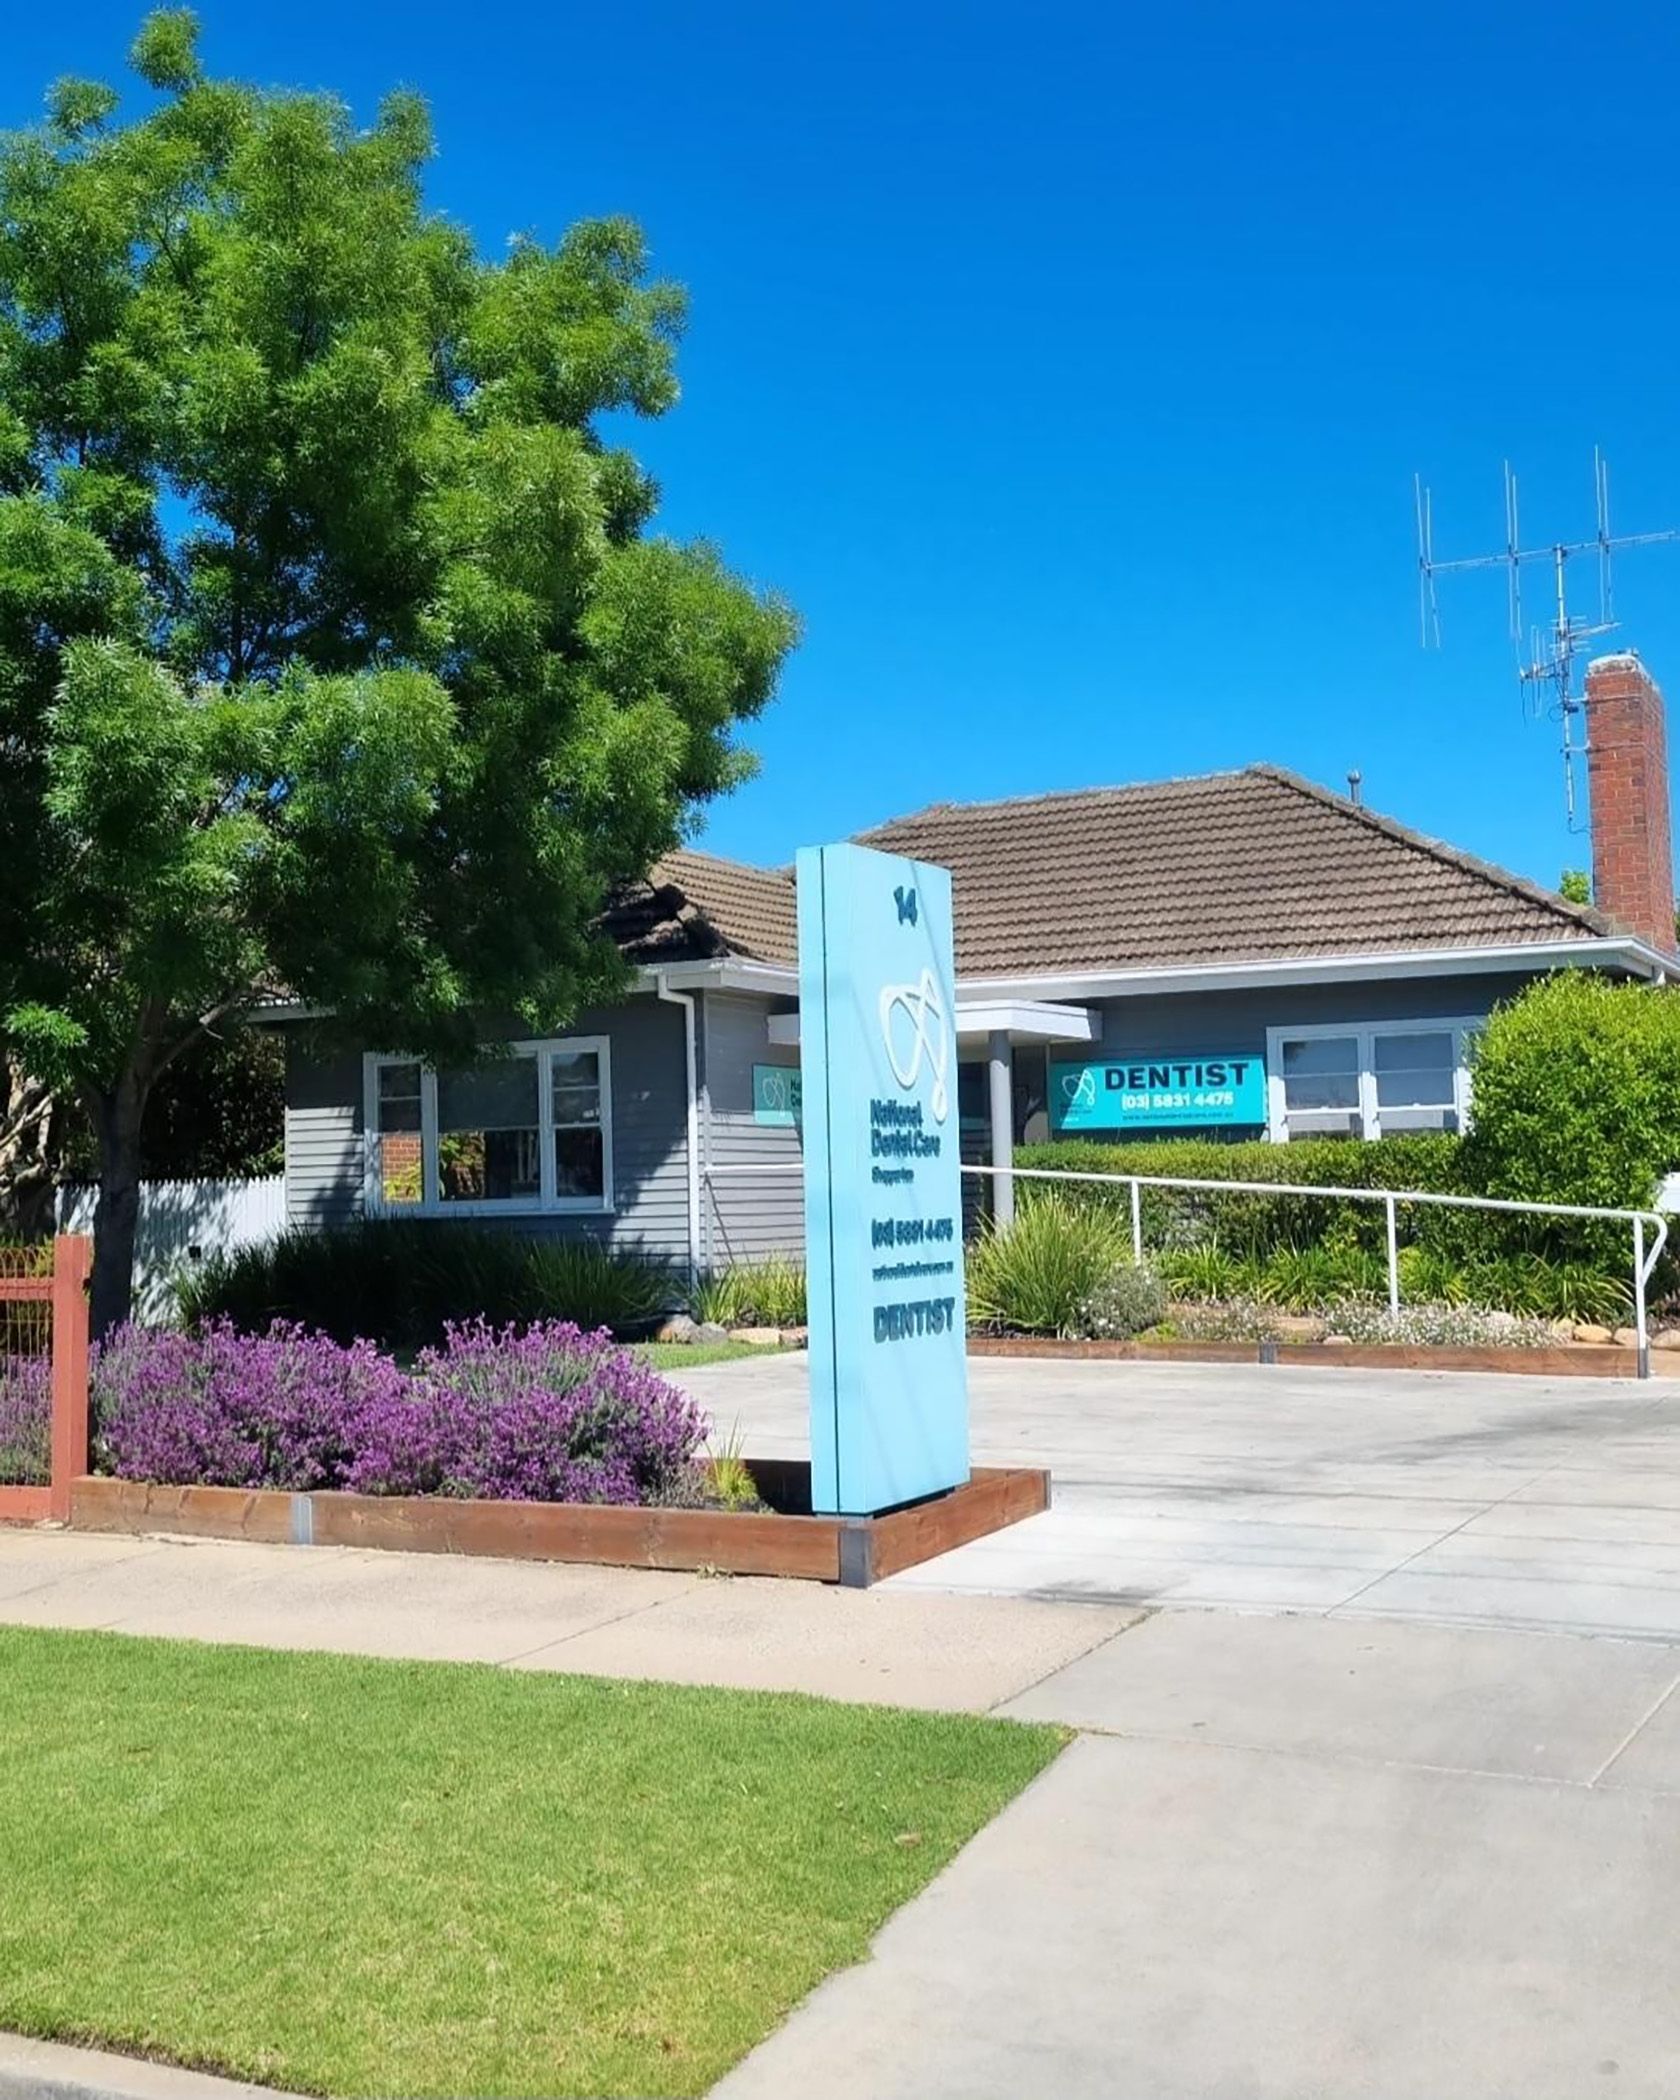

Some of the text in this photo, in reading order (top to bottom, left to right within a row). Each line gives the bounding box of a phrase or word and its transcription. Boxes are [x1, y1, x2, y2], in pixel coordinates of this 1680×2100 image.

[893, 885, 917, 927] 14
[1104, 1062, 1249, 1091] DENTIST
[870, 1099, 923, 1128] National
[1122, 1092, 1149, 1111] (03)
[871, 1129, 940, 1157] Dental Care
[873, 1297, 955, 1344] DENTIST
